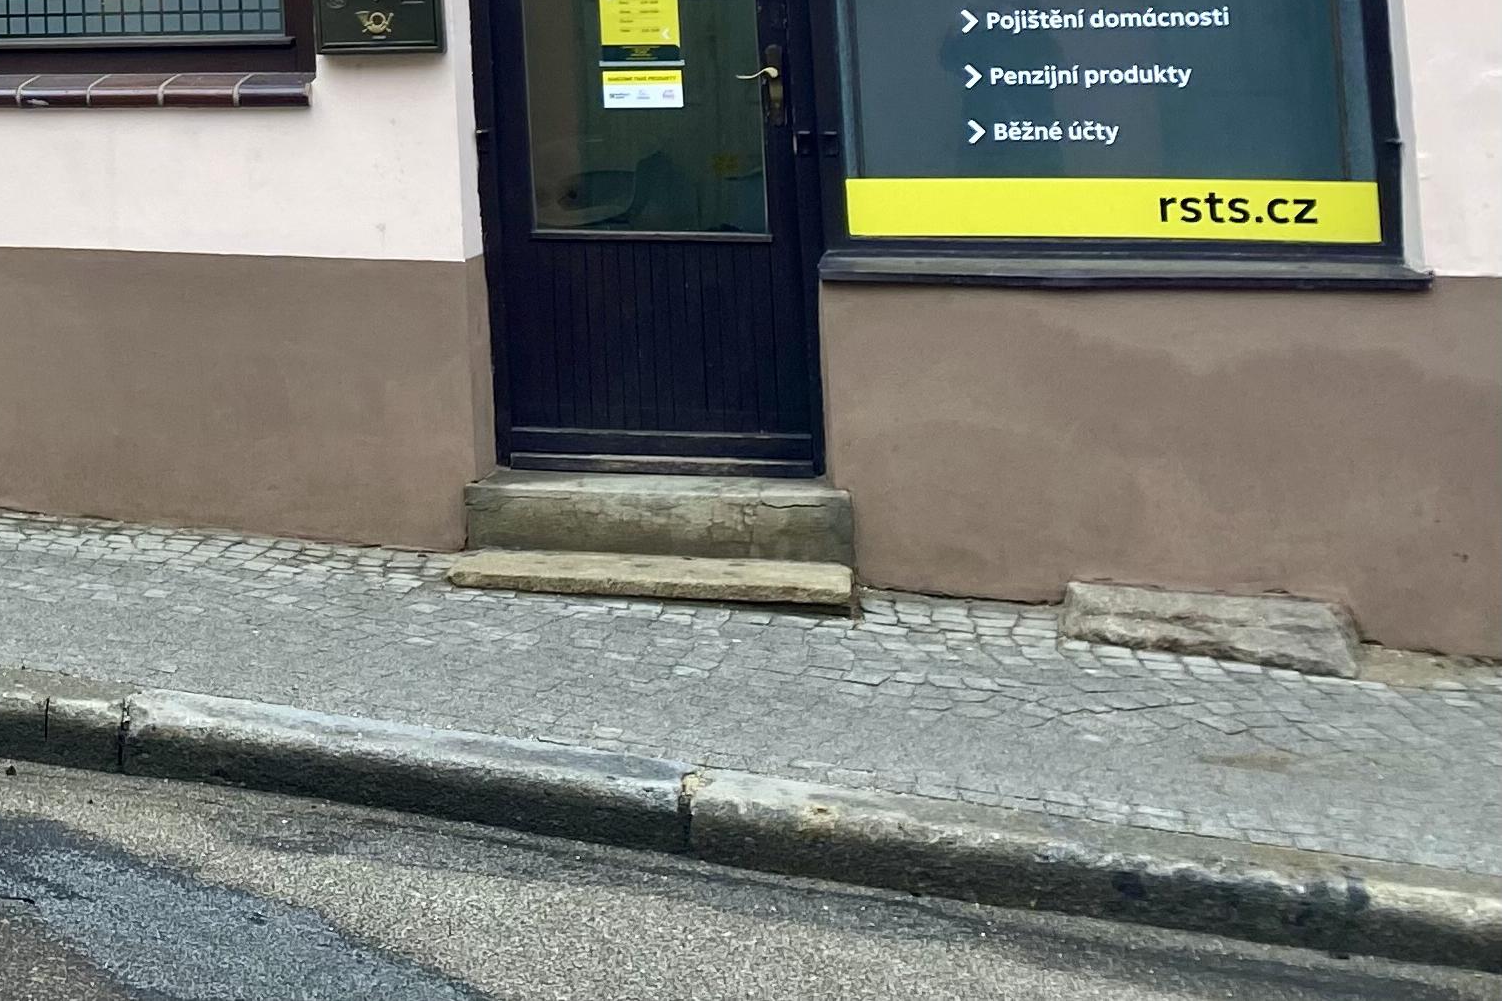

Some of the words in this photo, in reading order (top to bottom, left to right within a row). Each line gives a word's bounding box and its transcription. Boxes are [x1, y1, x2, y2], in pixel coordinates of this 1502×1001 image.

[986, 8, 1085, 34] Pojištění
[1088, 5, 1230, 29] domácnosti
[989, 64, 1080, 89] Penzijní
[1083, 64, 1193, 88] produkty
[993, 120, 1063, 141] Běžné
[1067, 120, 1120, 145] účty
[1159, 192, 1318, 225] rsts.cz
